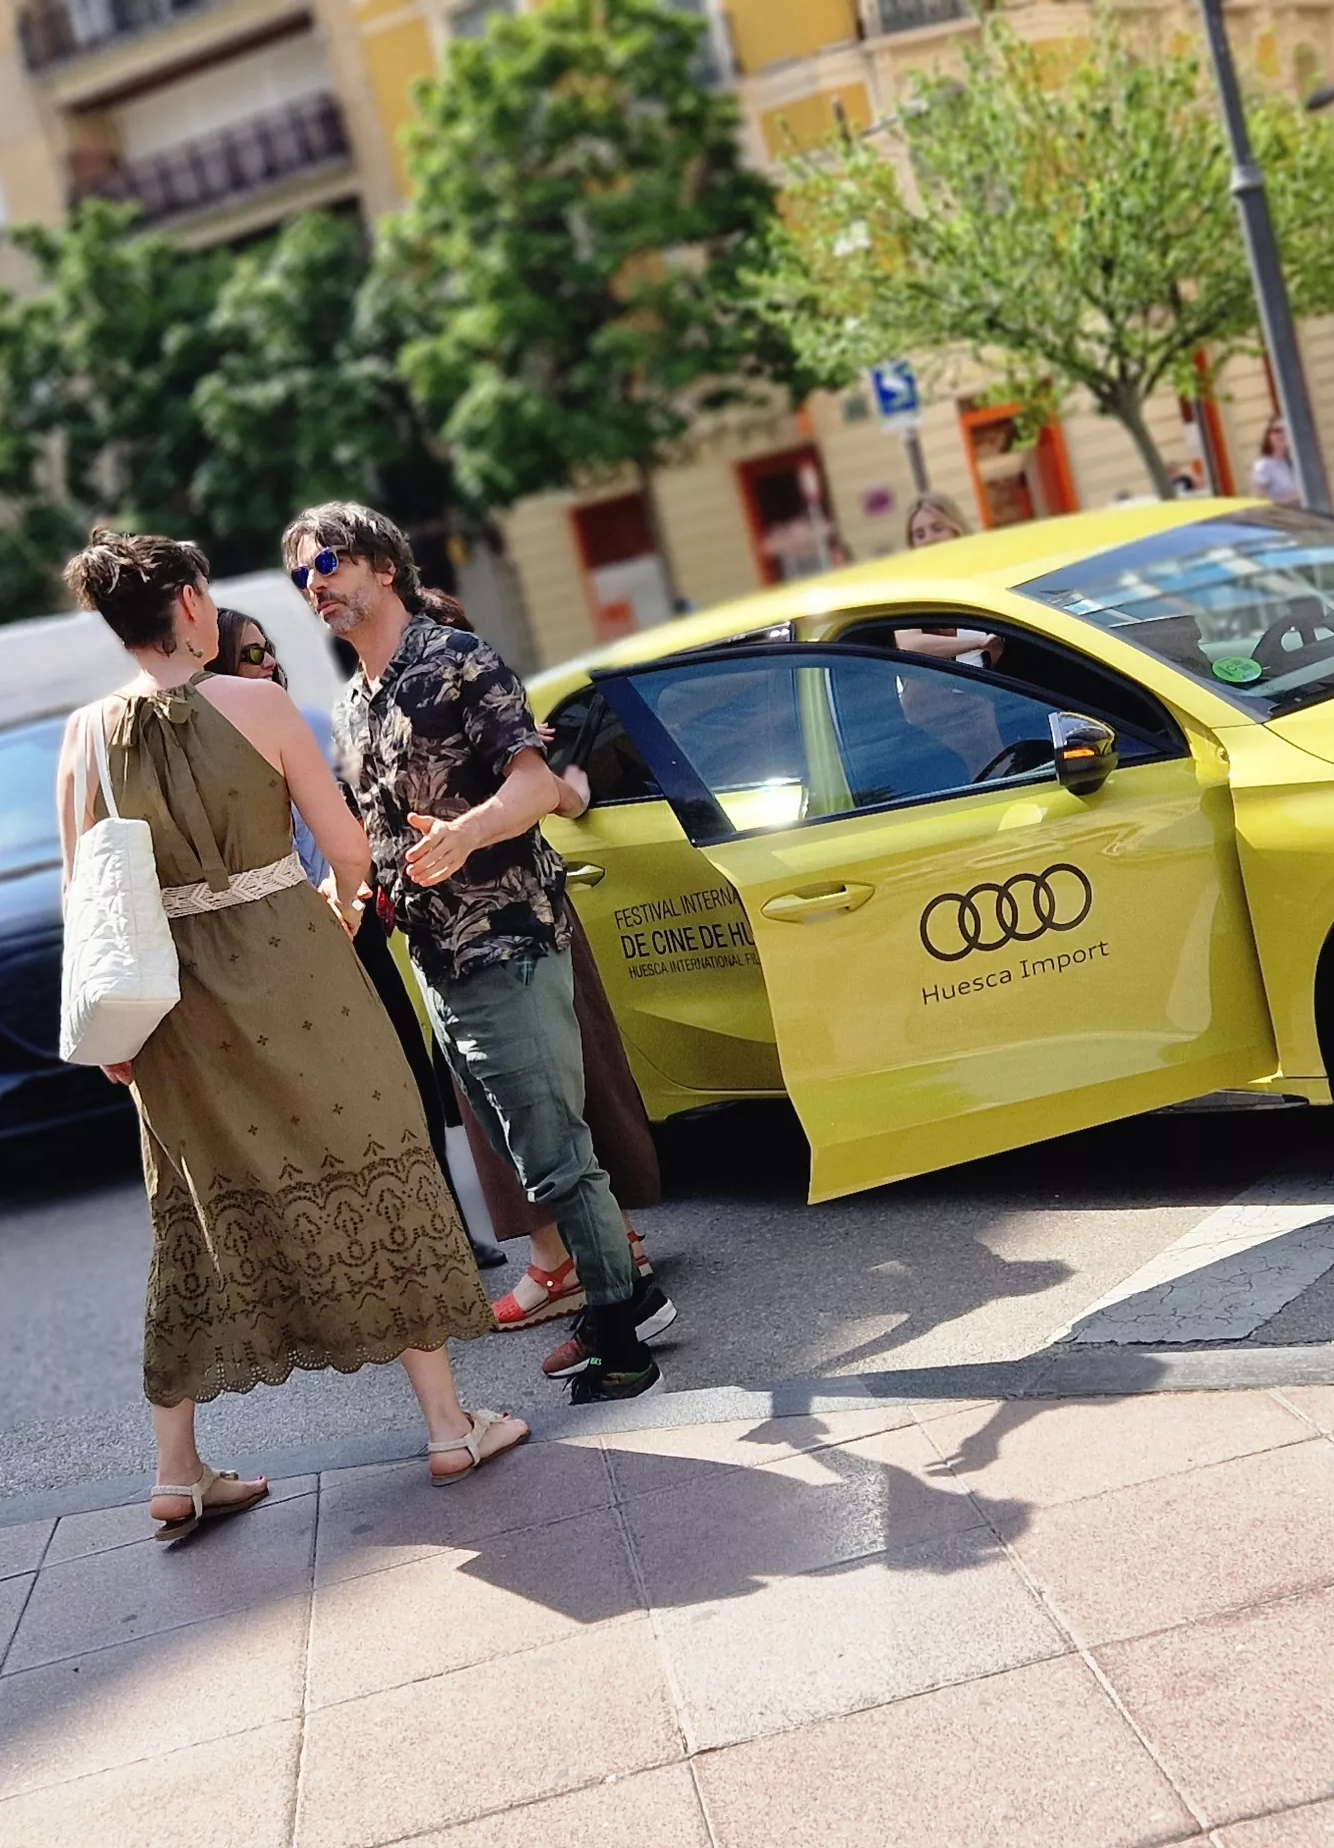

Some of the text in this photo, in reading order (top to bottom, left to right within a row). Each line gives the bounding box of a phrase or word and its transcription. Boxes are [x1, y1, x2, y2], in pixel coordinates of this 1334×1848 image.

[613, 898, 682, 929] FESTIVAL
[620, 932, 650, 960] DE
[651, 926, 699, 955] CINE
[698, 923, 728, 950] DE
[628, 961, 668, 979] HUESCA
[670, 953, 744, 974] INTERNATIONAL
[921, 940, 1110, 1005] Huesca Import
